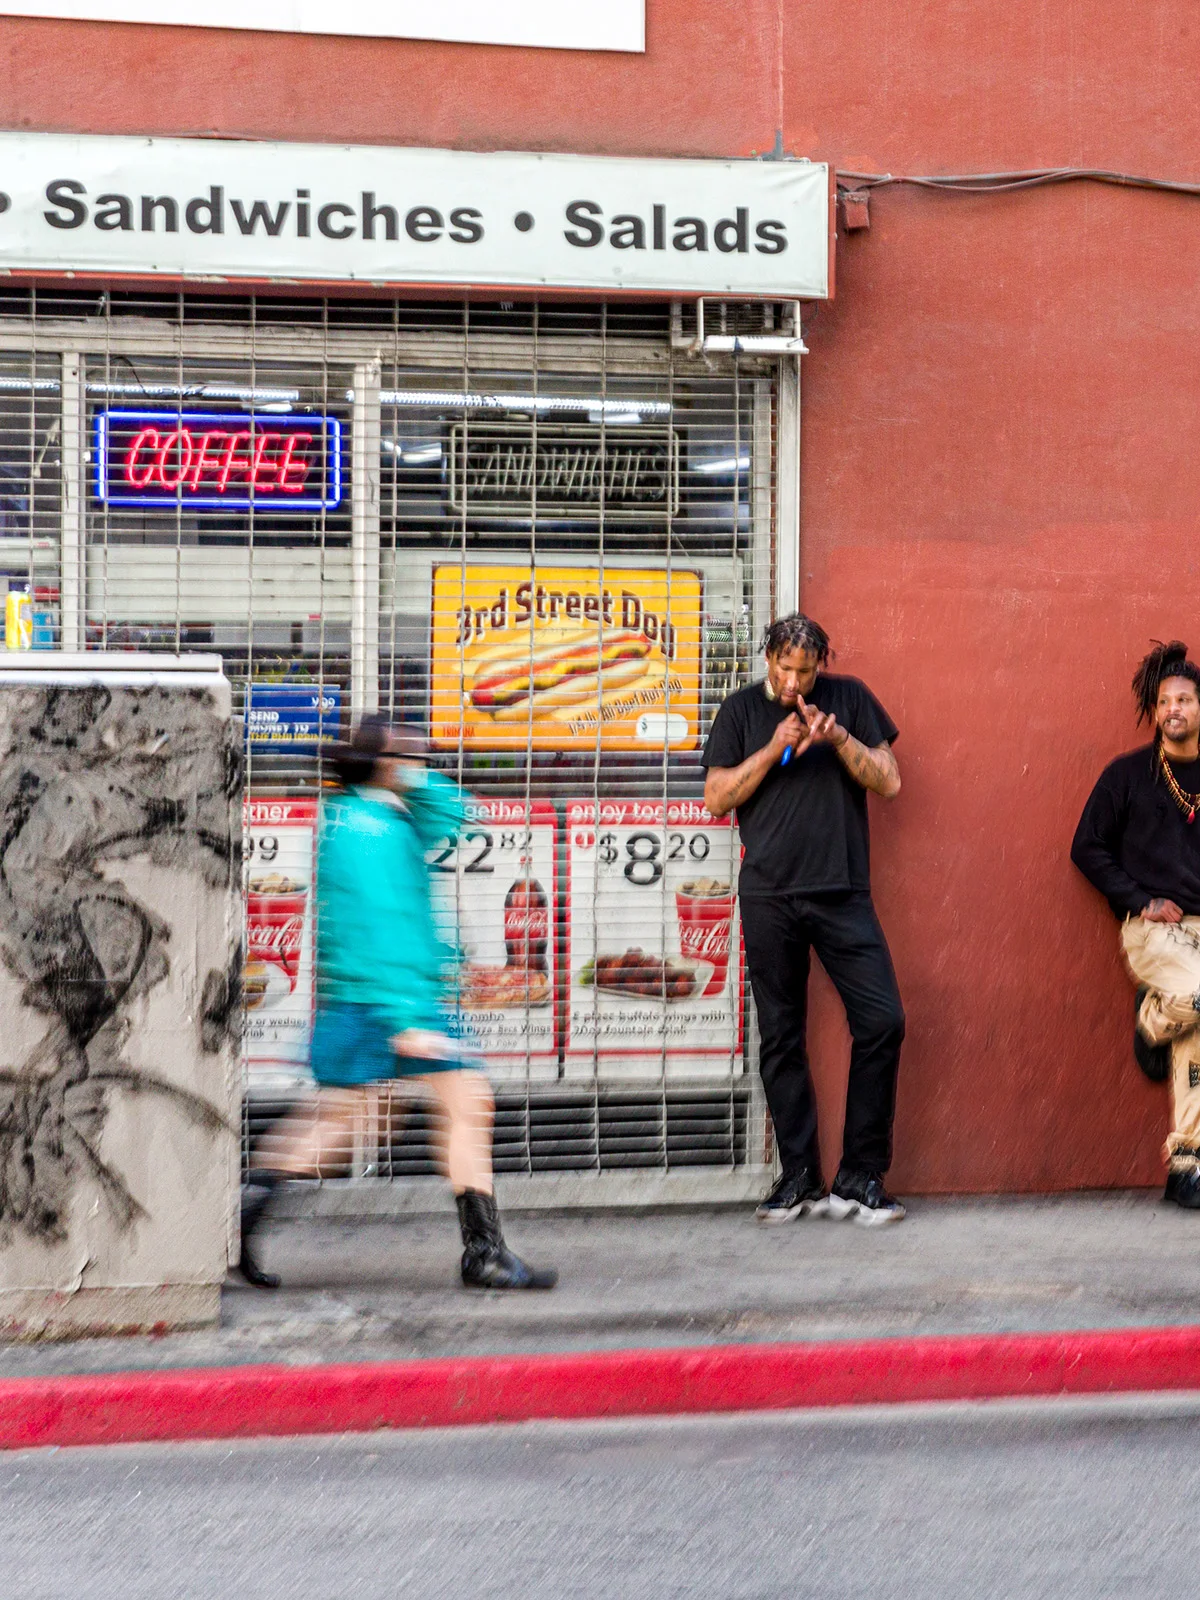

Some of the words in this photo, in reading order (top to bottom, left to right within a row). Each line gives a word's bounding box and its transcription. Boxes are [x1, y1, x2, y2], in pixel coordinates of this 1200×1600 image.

[44, 178, 485, 244] Sandwiches
[564, 199, 788, 255] Salads
[126, 428, 313, 492] COFFEE
[455, 588, 509, 648] 3rd
[514, 582, 615, 627] Street
[621, 589, 677, 660] Dog
[250, 711, 280, 723] SEND
[633, 801, 715, 823] togethe
